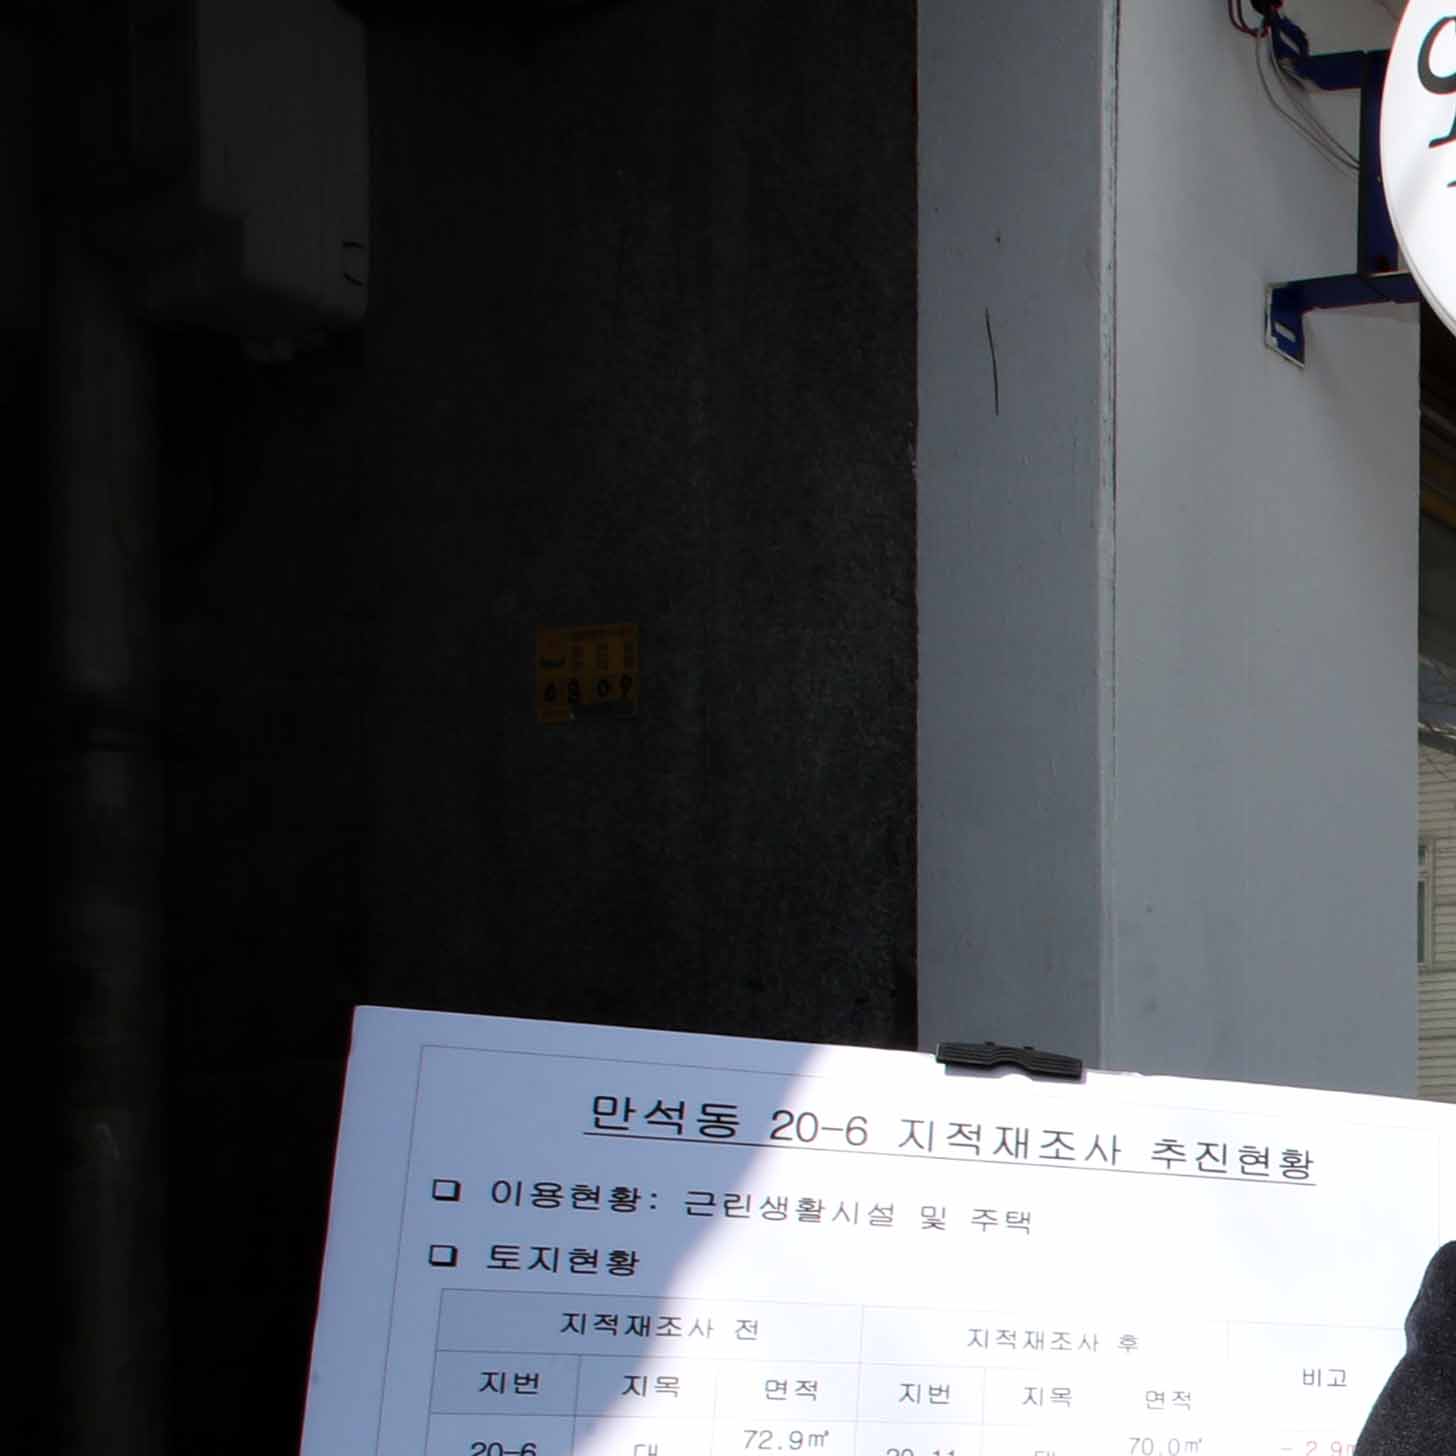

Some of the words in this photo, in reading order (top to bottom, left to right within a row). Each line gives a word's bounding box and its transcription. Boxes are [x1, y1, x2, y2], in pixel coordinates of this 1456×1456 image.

[592, 1094, 740, 1139] 만석동
[768, 1110, 868, 1148] 20-6
[898, 1118, 1122, 1166] 지적재조사
[1150, 1139, 1314, 1181] 추진현황
[491, 1180, 657, 1213] 이용현황:
[684, 1191, 894, 1227] 근린생활시설
[921, 1206, 946, 1230] 및
[971, 1209, 1031, 1235] 주택
[486, 1245, 640, 1276] 토지현황
[560, 1313, 714, 1338] 지적재조사
[735, 1320, 758, 1340] 전
[968, 1329, 1099, 1352] 지적재조사
[1118, 1334, 1137, 1352] 후
[478, 1372, 539, 1395] 지번
[622, 1376, 680, 1398] 지목
[1303, 1368, 1347, 1387] 비고
[765, 1380, 818, 1401] 면적
[899, 1384, 950, 1404] 지번
[1022, 1387, 1072, 1407] 지목
[1146, 1390, 1191, 1410] 면적
